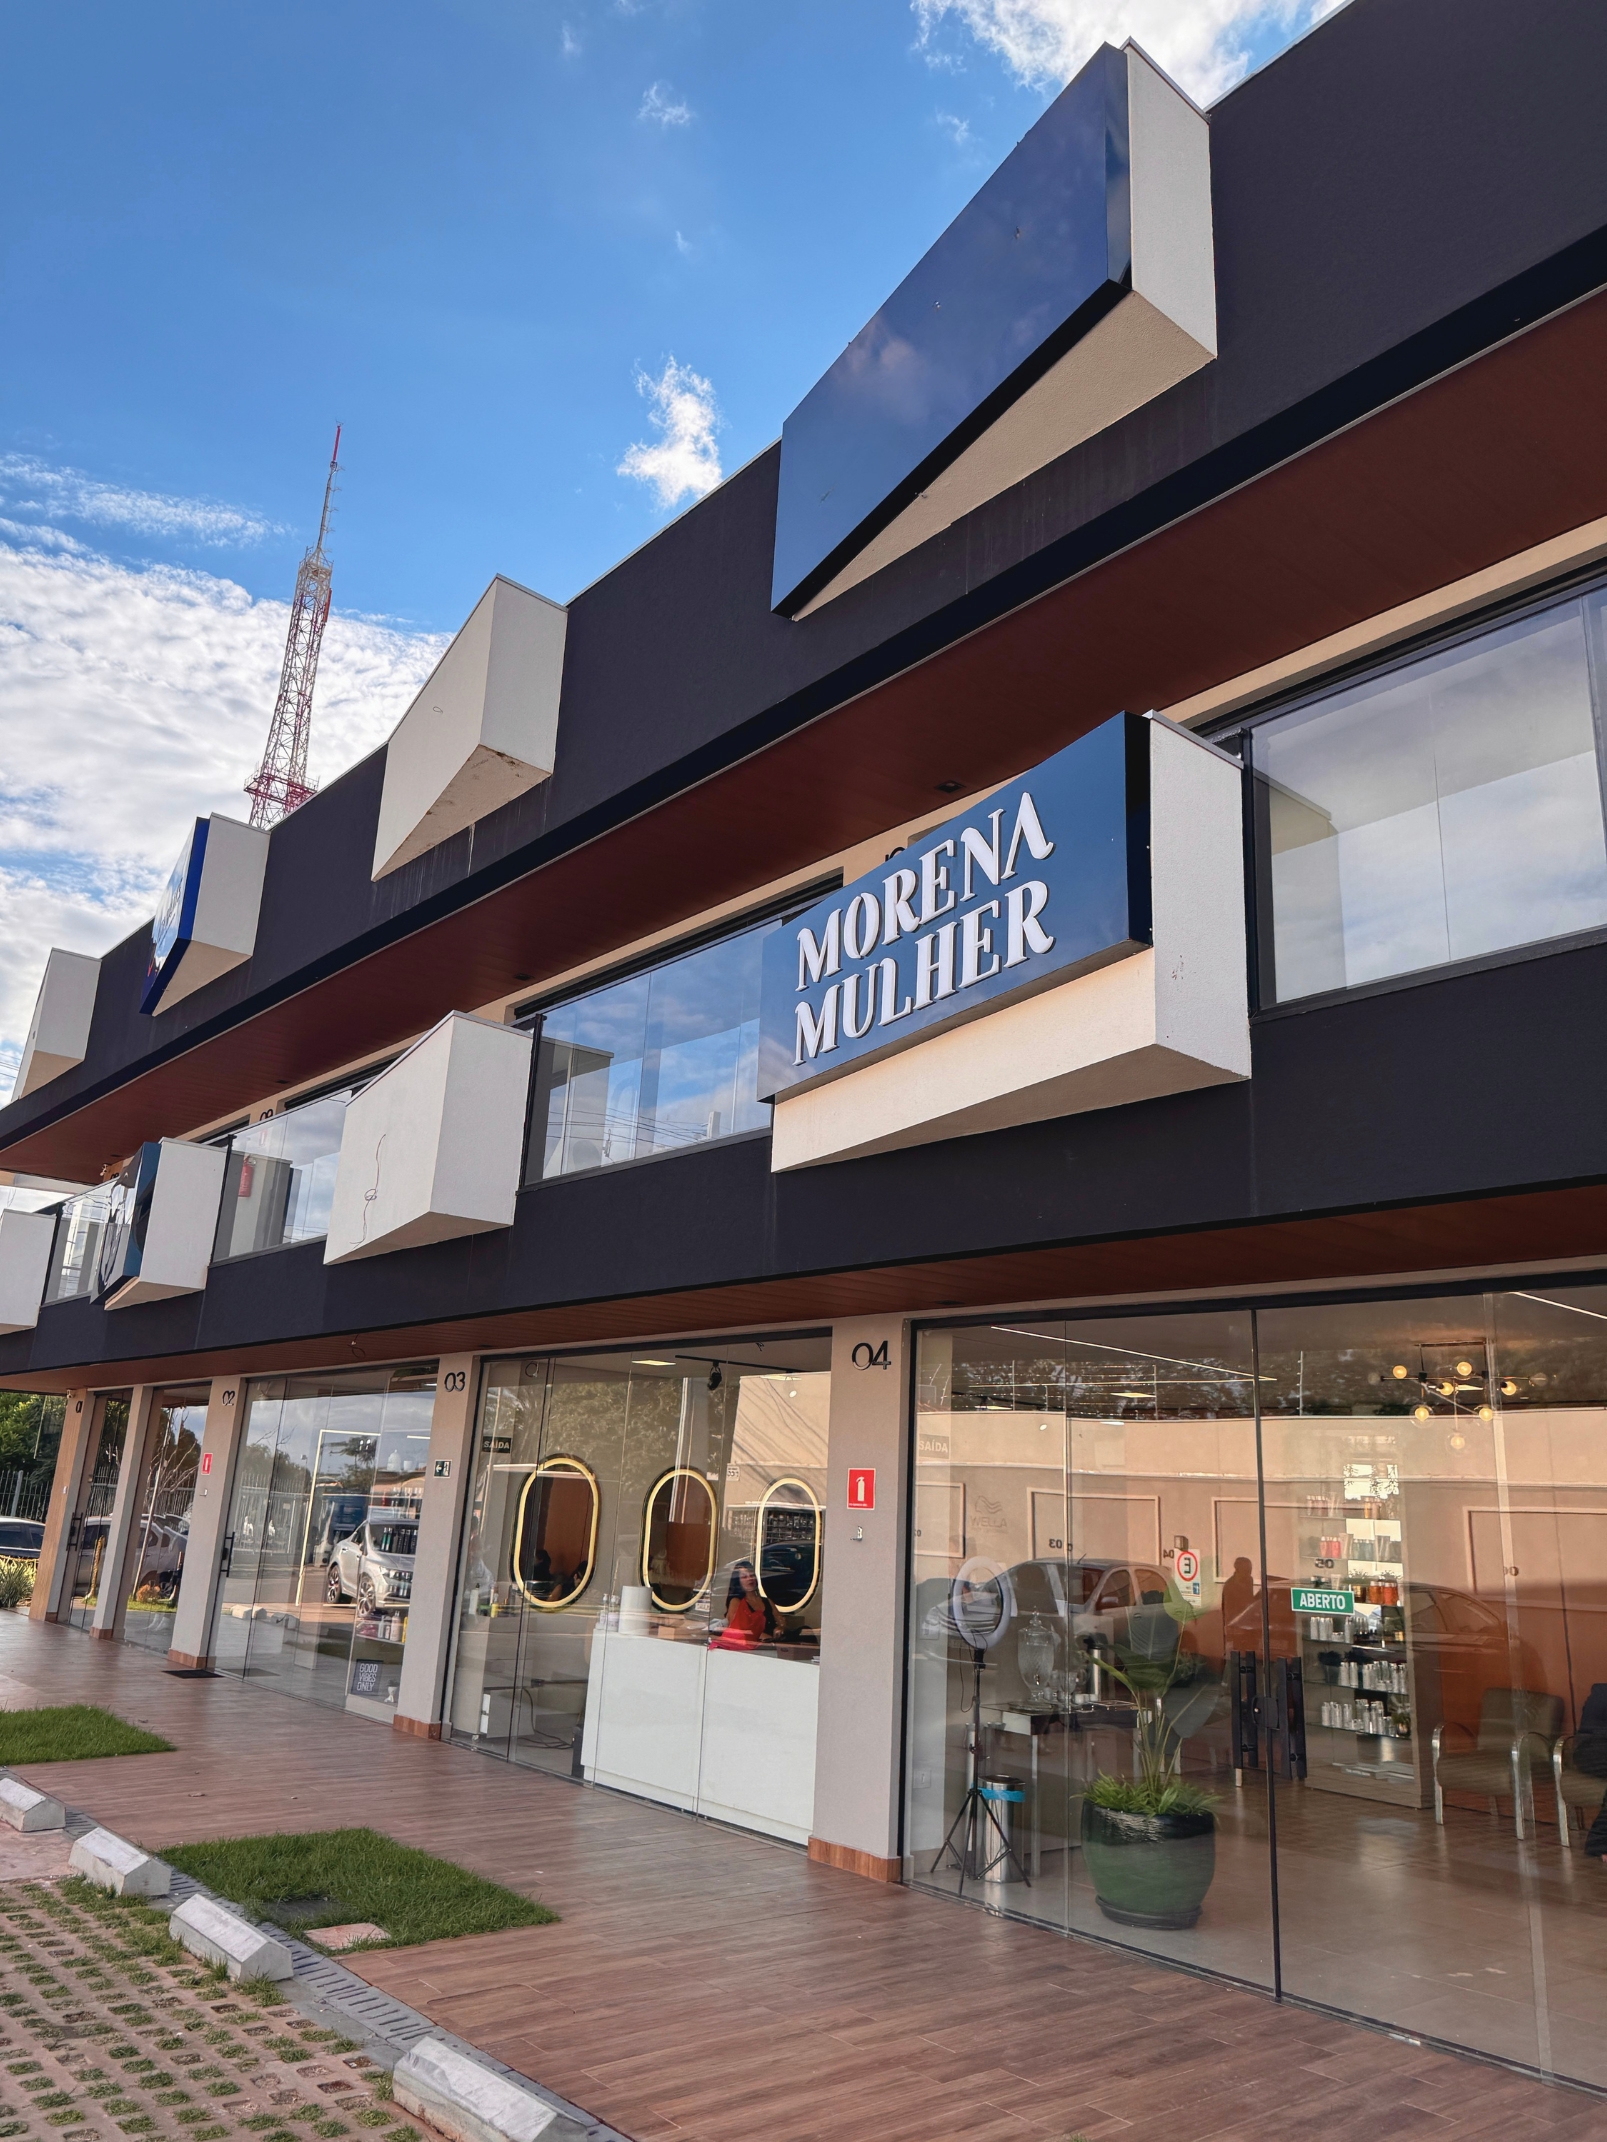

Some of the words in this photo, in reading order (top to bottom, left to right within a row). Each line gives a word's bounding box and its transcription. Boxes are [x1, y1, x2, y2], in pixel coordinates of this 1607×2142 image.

[795, 791, 1054, 992] MORENA
[792, 880, 1055, 1066] MULHER
[851, 1340, 892, 1371] 04
[444, 1371, 466, 1392] 03
[222, 1390, 236, 1406] 02
[918, 1439, 948, 1453] SAÍDA
[1299, 1592, 1346, 1610] ABERTO
[359, 1663, 378, 1673] GOOD
[358, 1672, 377, 1682] VIBES
[356, 1681, 375, 1692] ONLY
